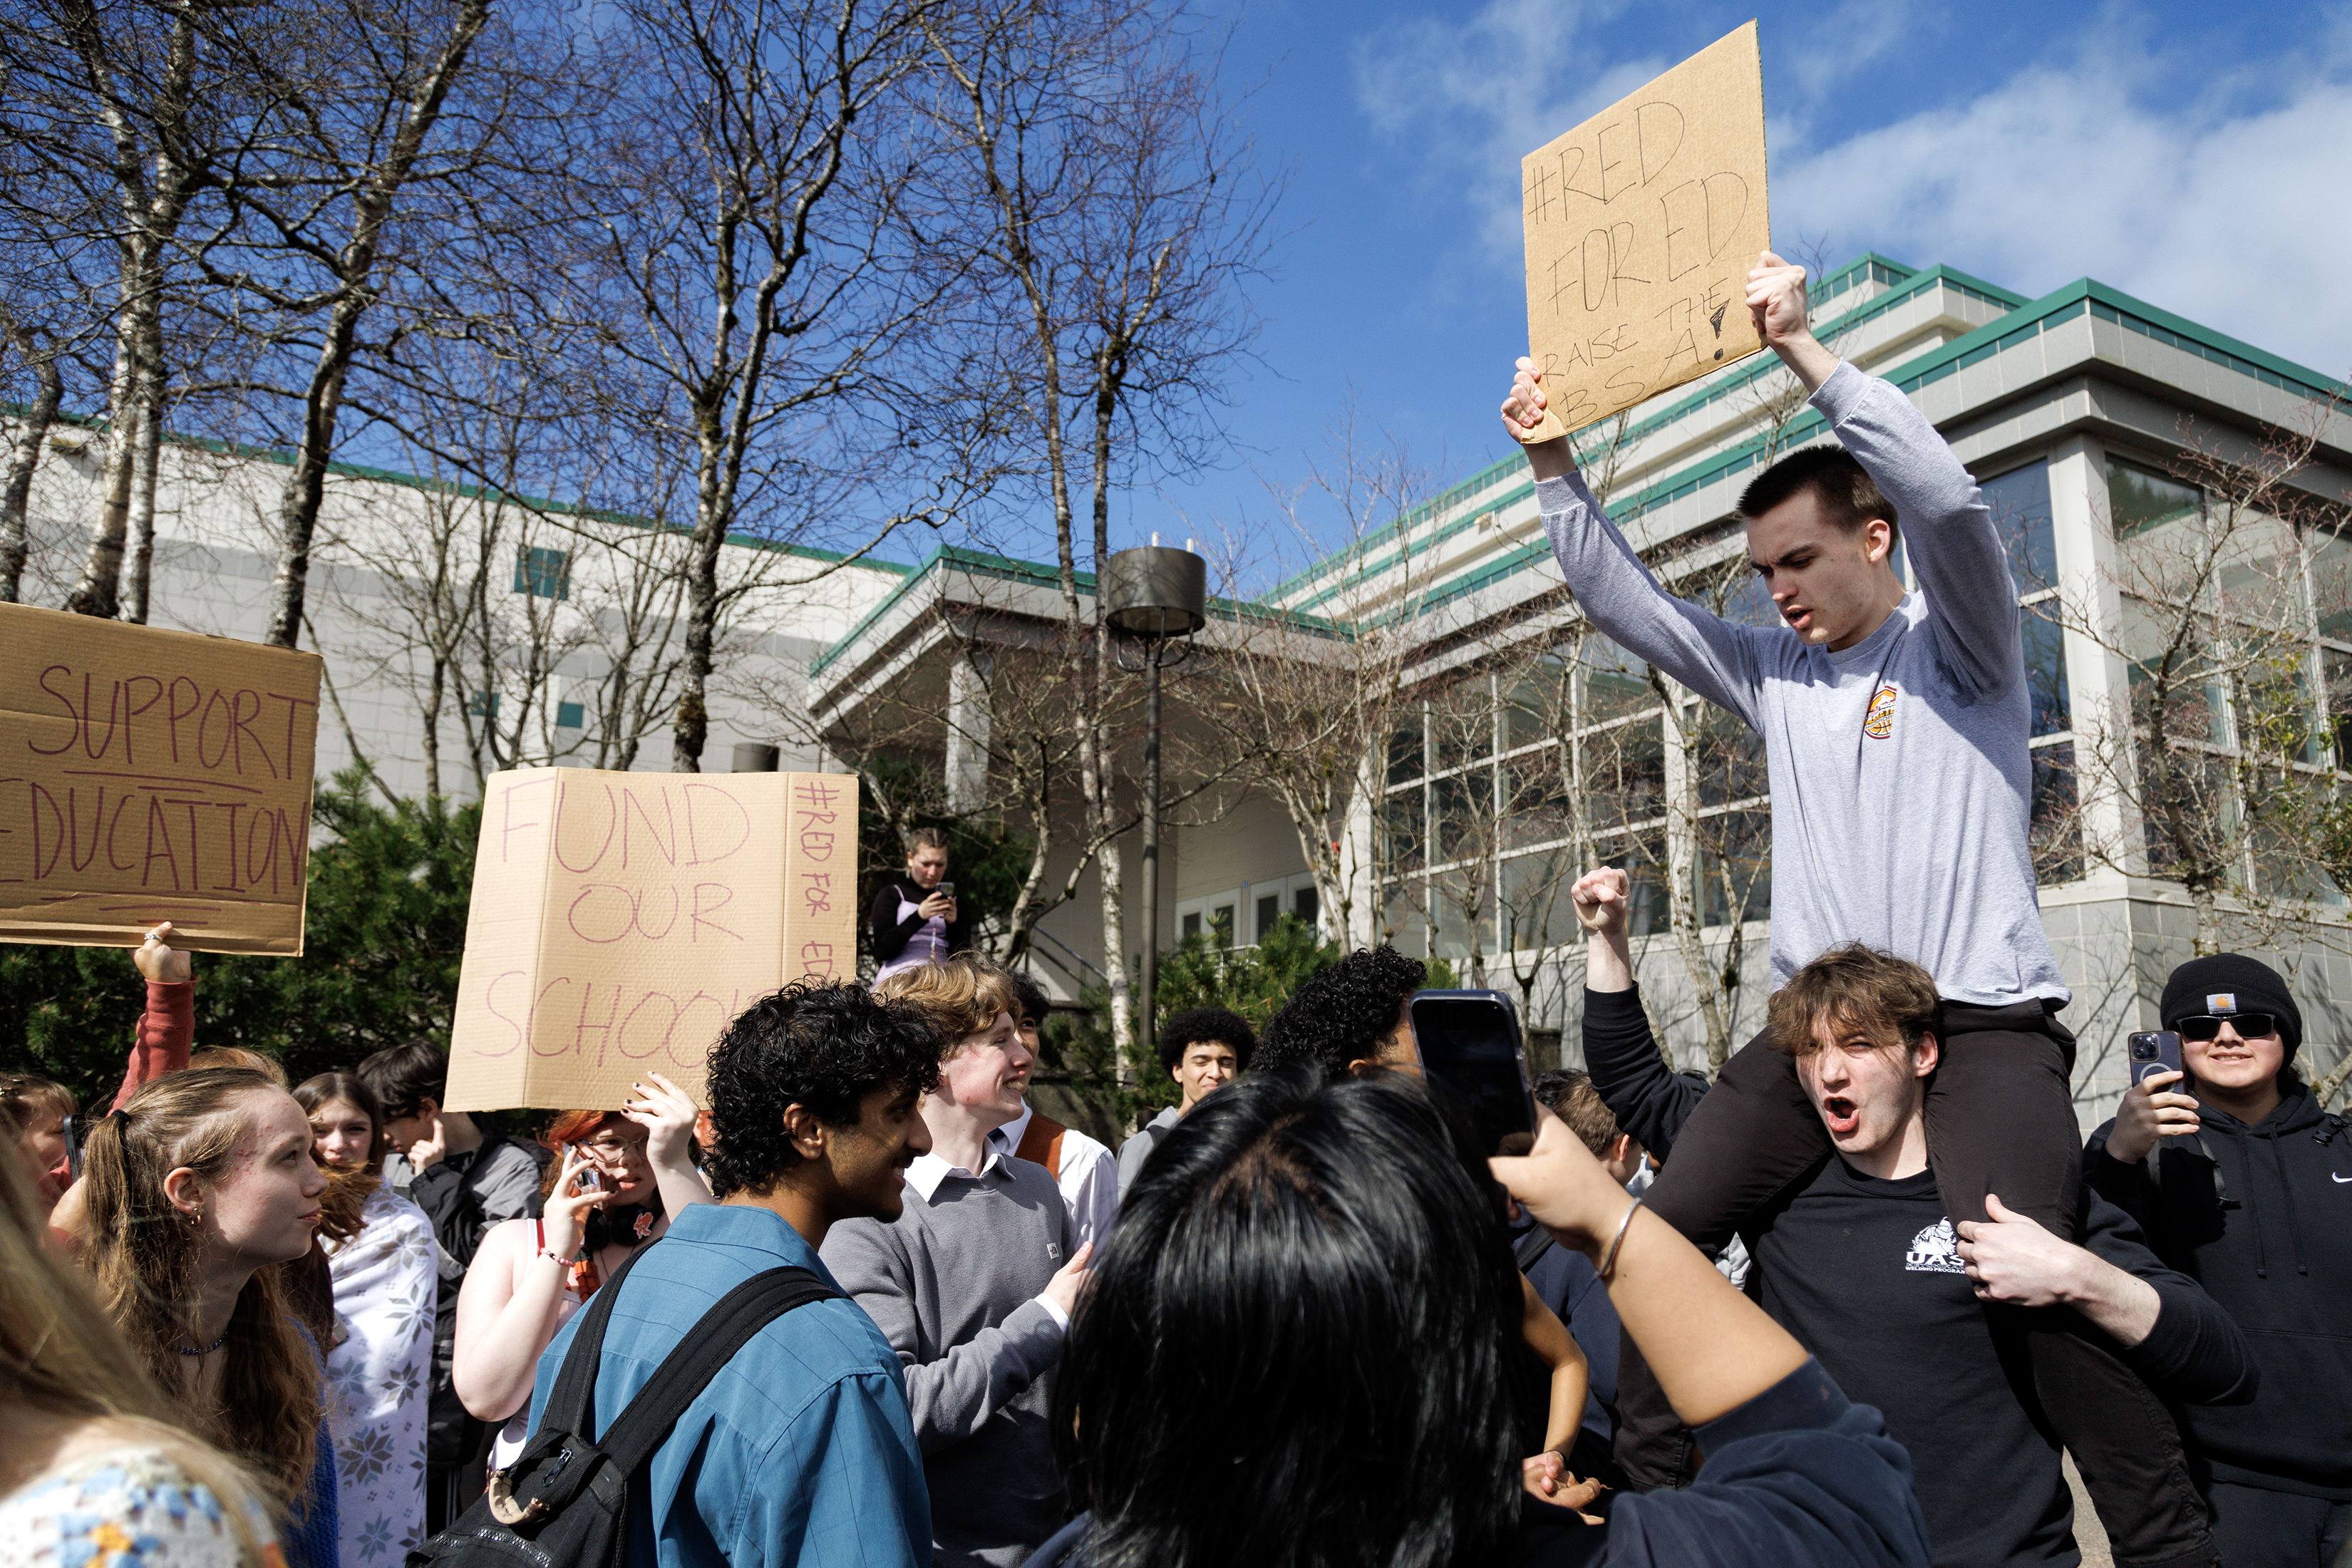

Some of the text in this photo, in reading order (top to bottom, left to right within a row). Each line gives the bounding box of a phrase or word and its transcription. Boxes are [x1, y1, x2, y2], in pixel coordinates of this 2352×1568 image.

[1524, 100, 1686, 225] #RED
[1547, 171, 1748, 316] FOR ED
[1542, 277, 1729, 387] RAISE THE
[28, 665, 316, 780] SUPPORT
[500, 776, 751, 873] FUND
[794, 781, 840, 862] #RED
[568, 882, 744, 943] OUR
[801, 872, 832, 918] FOR
[472, 969, 780, 1068] SCHOO
[1906, 1251, 1966, 1267] UAS
